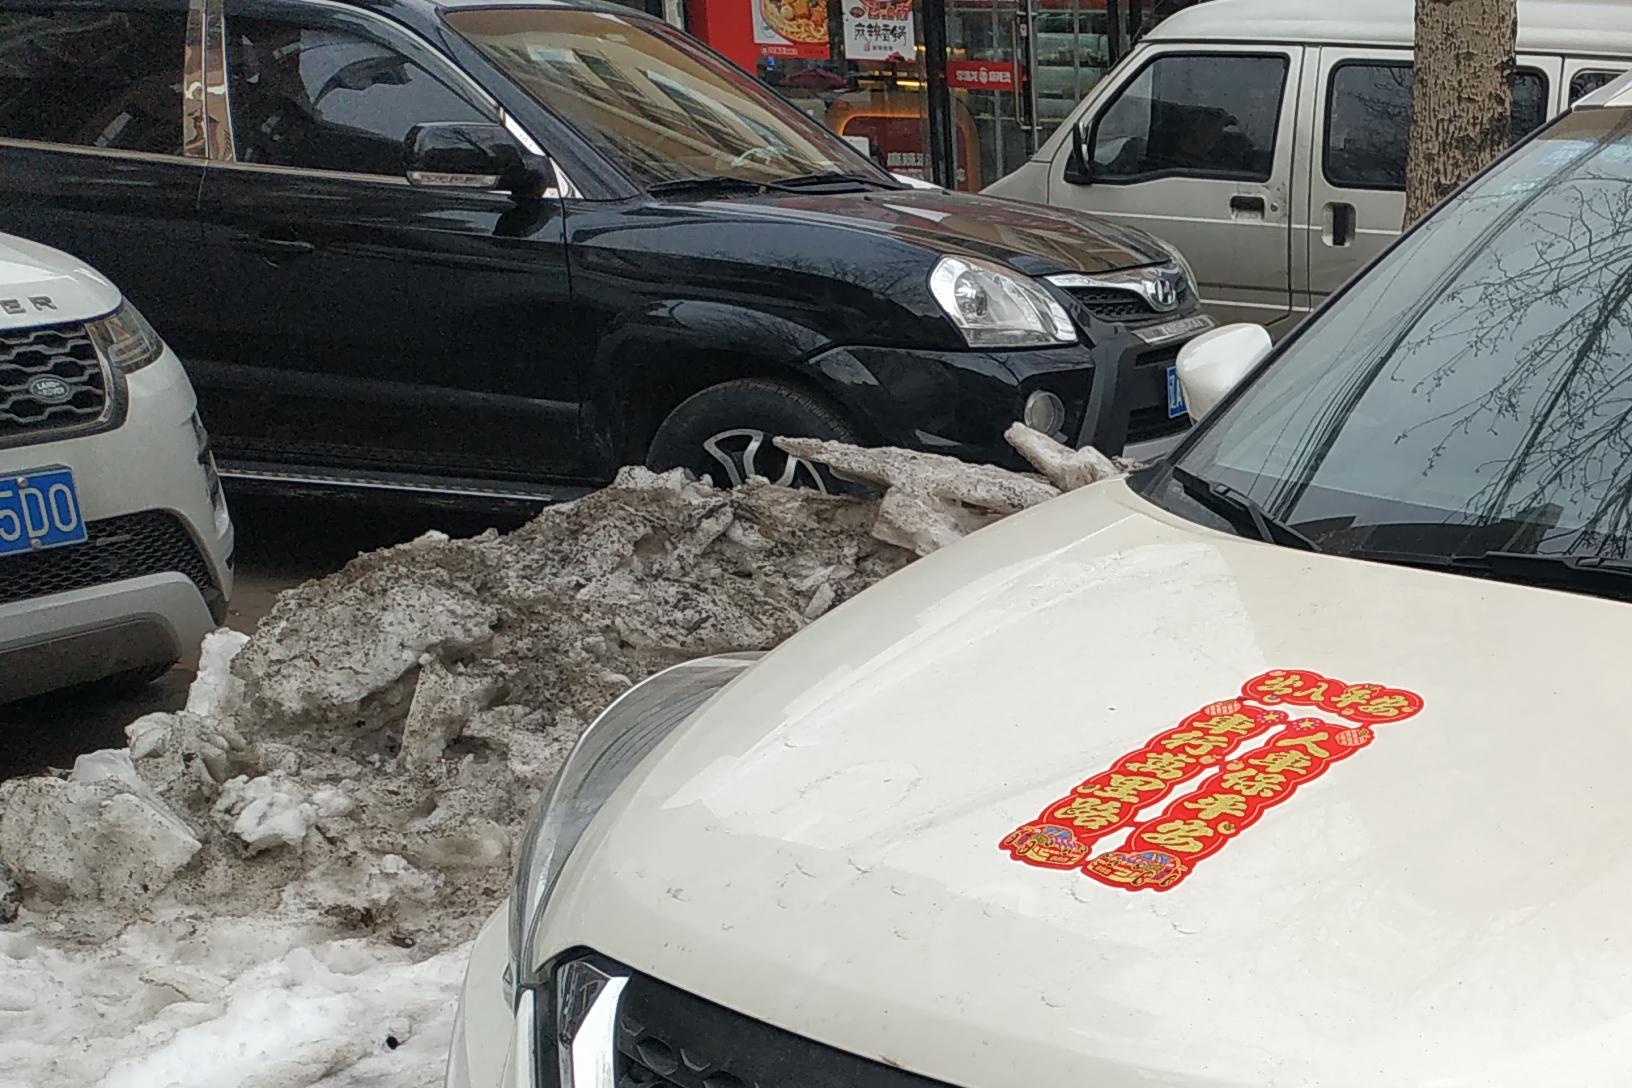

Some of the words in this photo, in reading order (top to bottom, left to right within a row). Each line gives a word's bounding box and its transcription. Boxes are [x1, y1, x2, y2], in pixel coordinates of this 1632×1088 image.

[854, 22, 907, 46] 麻辣香锅
[36, 381, 60, 391] LAND
[1258, 675, 1408, 716] 出入平安
